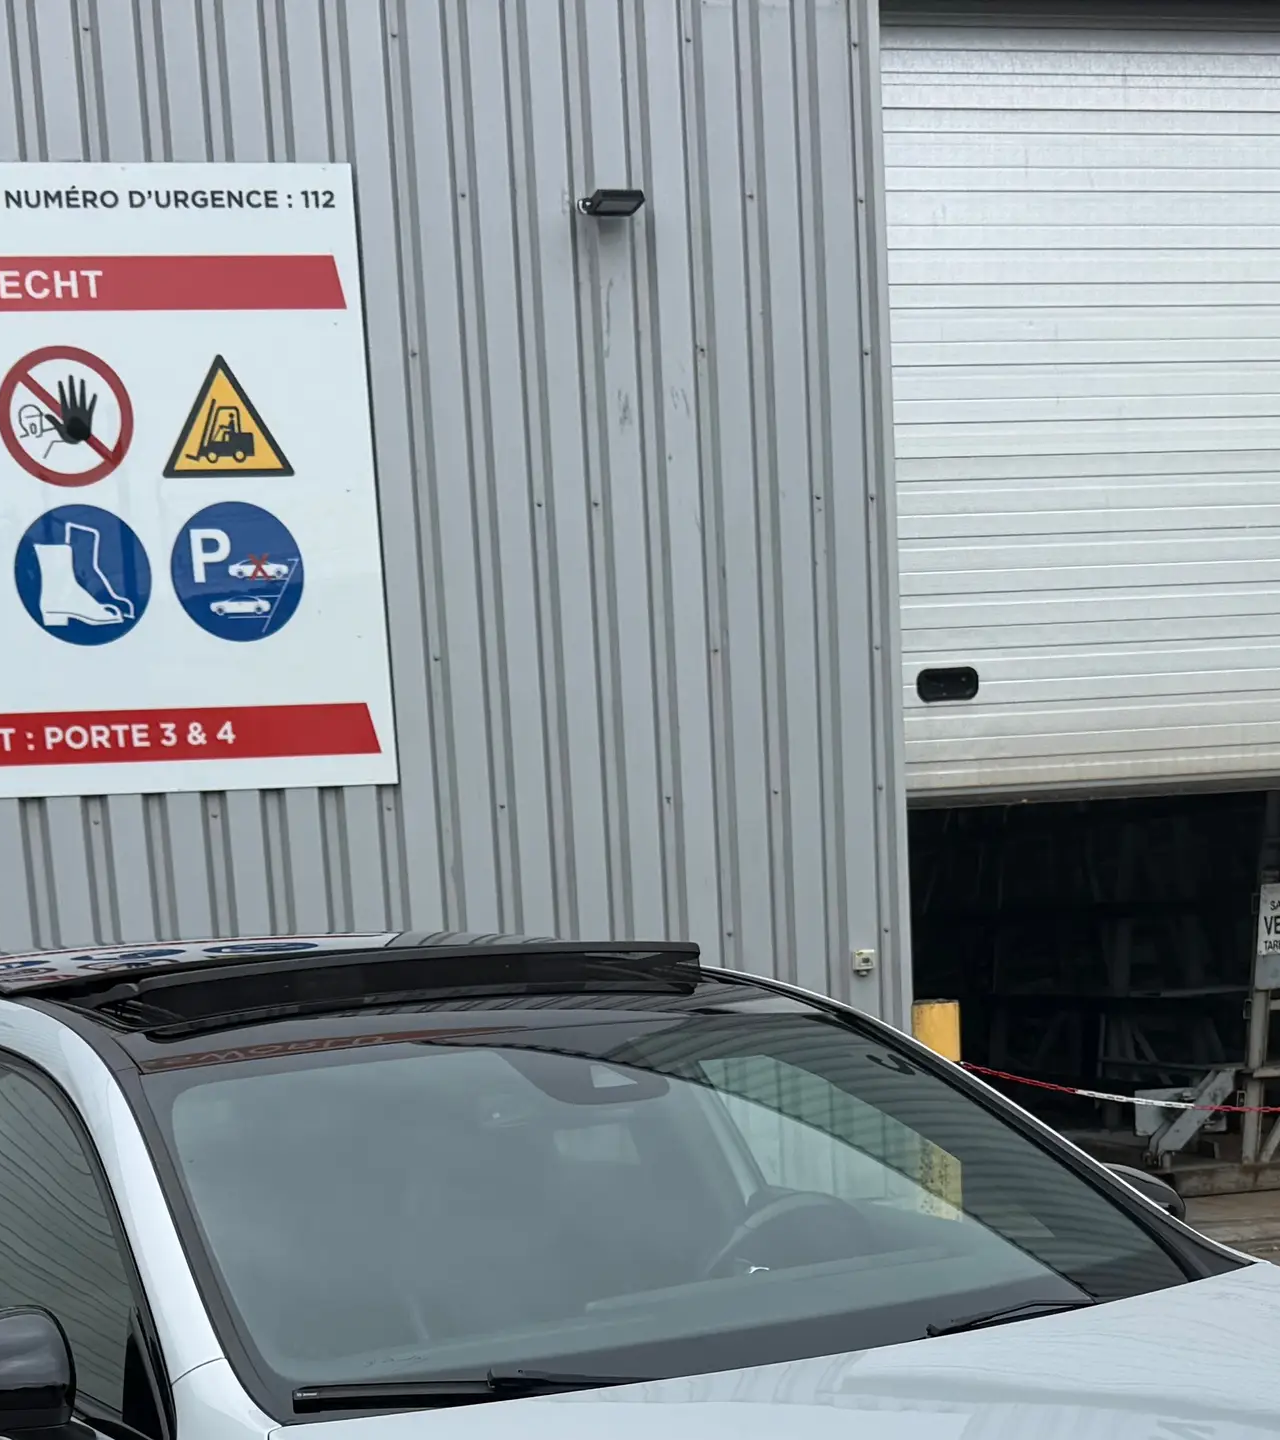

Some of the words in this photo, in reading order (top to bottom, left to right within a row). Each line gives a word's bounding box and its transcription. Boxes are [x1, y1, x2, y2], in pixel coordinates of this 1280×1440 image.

[4, 185, 119, 209] NUMÉRO
[128, 190, 279, 209] D'URGENCE
[300, 190, 336, 209] 112
[189, 528, 231, 583] P
[45, 724, 150, 750] PORTE
[160, 723, 177, 746] 3
[187, 722, 207, 745] &
[216, 721, 236, 744] 4
